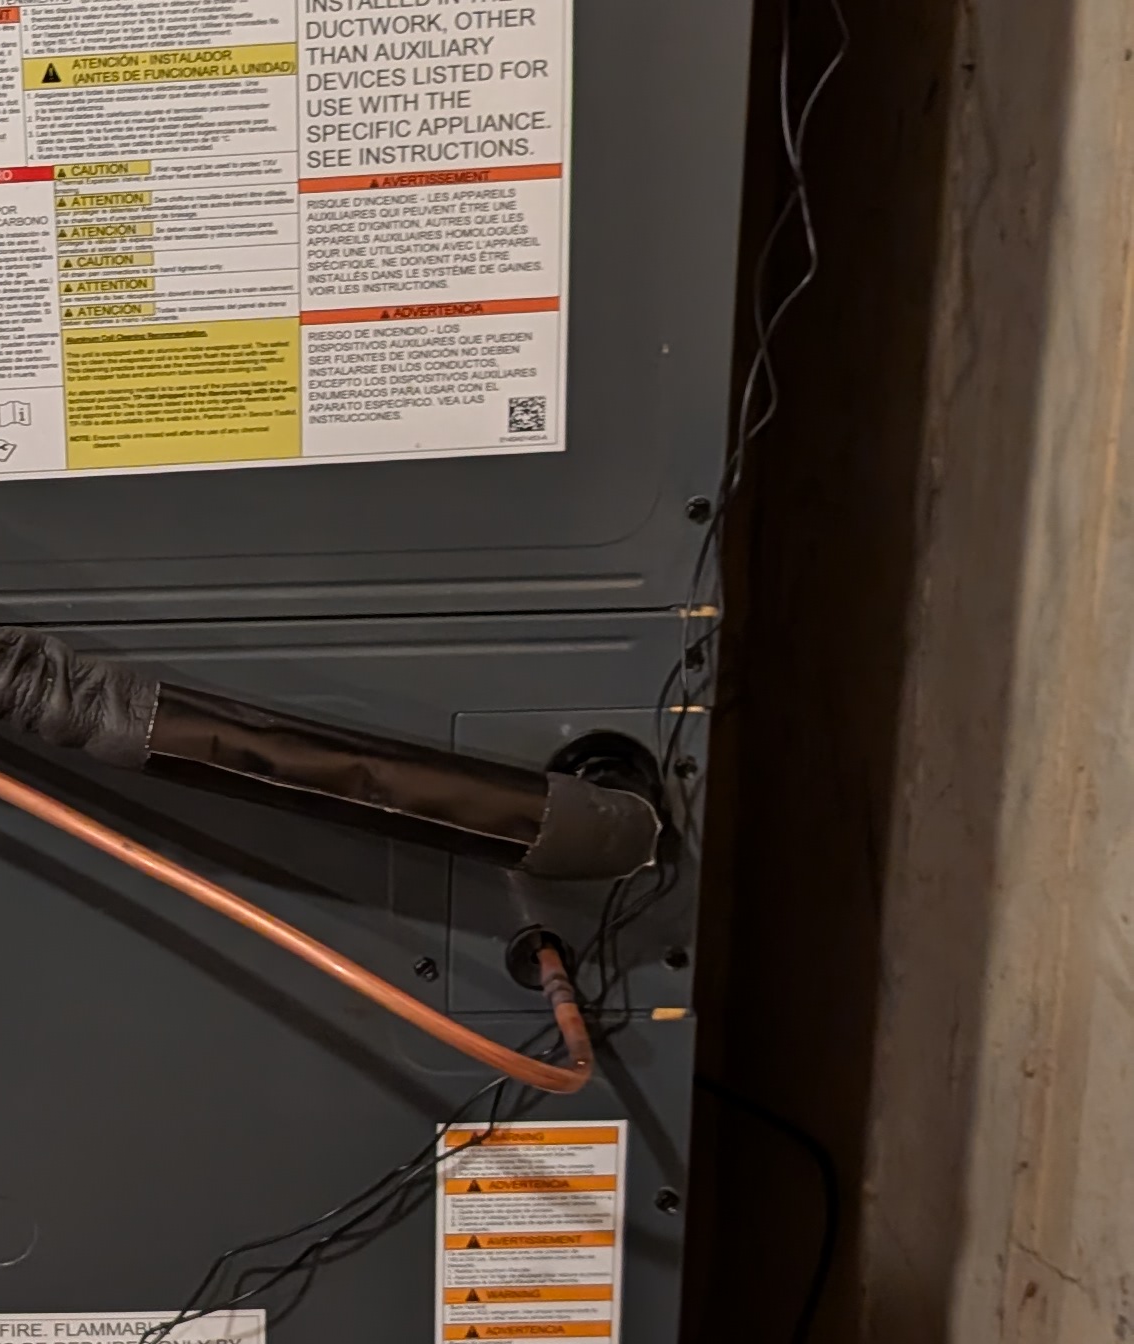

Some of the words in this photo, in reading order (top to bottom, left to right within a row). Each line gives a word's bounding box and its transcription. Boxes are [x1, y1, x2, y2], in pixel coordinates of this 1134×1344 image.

[305, 14, 447, 39] DUCTWORK,
[454, 9, 535, 31] OTHER
[305, 44, 368, 65] THAN
[372, 36, 495, 61] AUXILIARY
[71, 55, 138, 69] ATENCIÓN
[149, 50, 232, 65] INSTALADOR
[72, 71, 119, 84] (ANTES
[122, 70, 140, 81] DE
[143, 66, 219, 80] FUNCIONAR
[222, 65, 238, 76] LA
[241, 62, 298, 75] UNIDAD)
[306, 68, 406, 91] DEVICES
[412, 63, 493, 85] LISTED
[499, 60, 548, 80] FOR
[306, 97, 352, 117] USE
[359, 93, 419, 114] WITH
[425, 90, 471, 110] THE
[305, 119, 411, 142] SPECIFIC
[416, 111, 551, 136] APPLIANCE.
[306, 148, 351, 168] SEE
[358, 138, 533, 165] INSTRUCTIONS.
[71, 163, 129, 175] CAUTION
[382, 171, 491, 186] AVERTISSEMENT
[71, 193, 144, 205] ATTENTION
[72, 223, 137, 236] ATENCIÓN
[76, 254, 134, 266] CAUTION
[77, 279, 148, 291] ATTENTION
[77, 302, 142, 316] ATENCIÓN
[394, 304, 484, 317] ADVERTENCIA
[0, 1323, 47, 1337] FIRE.
